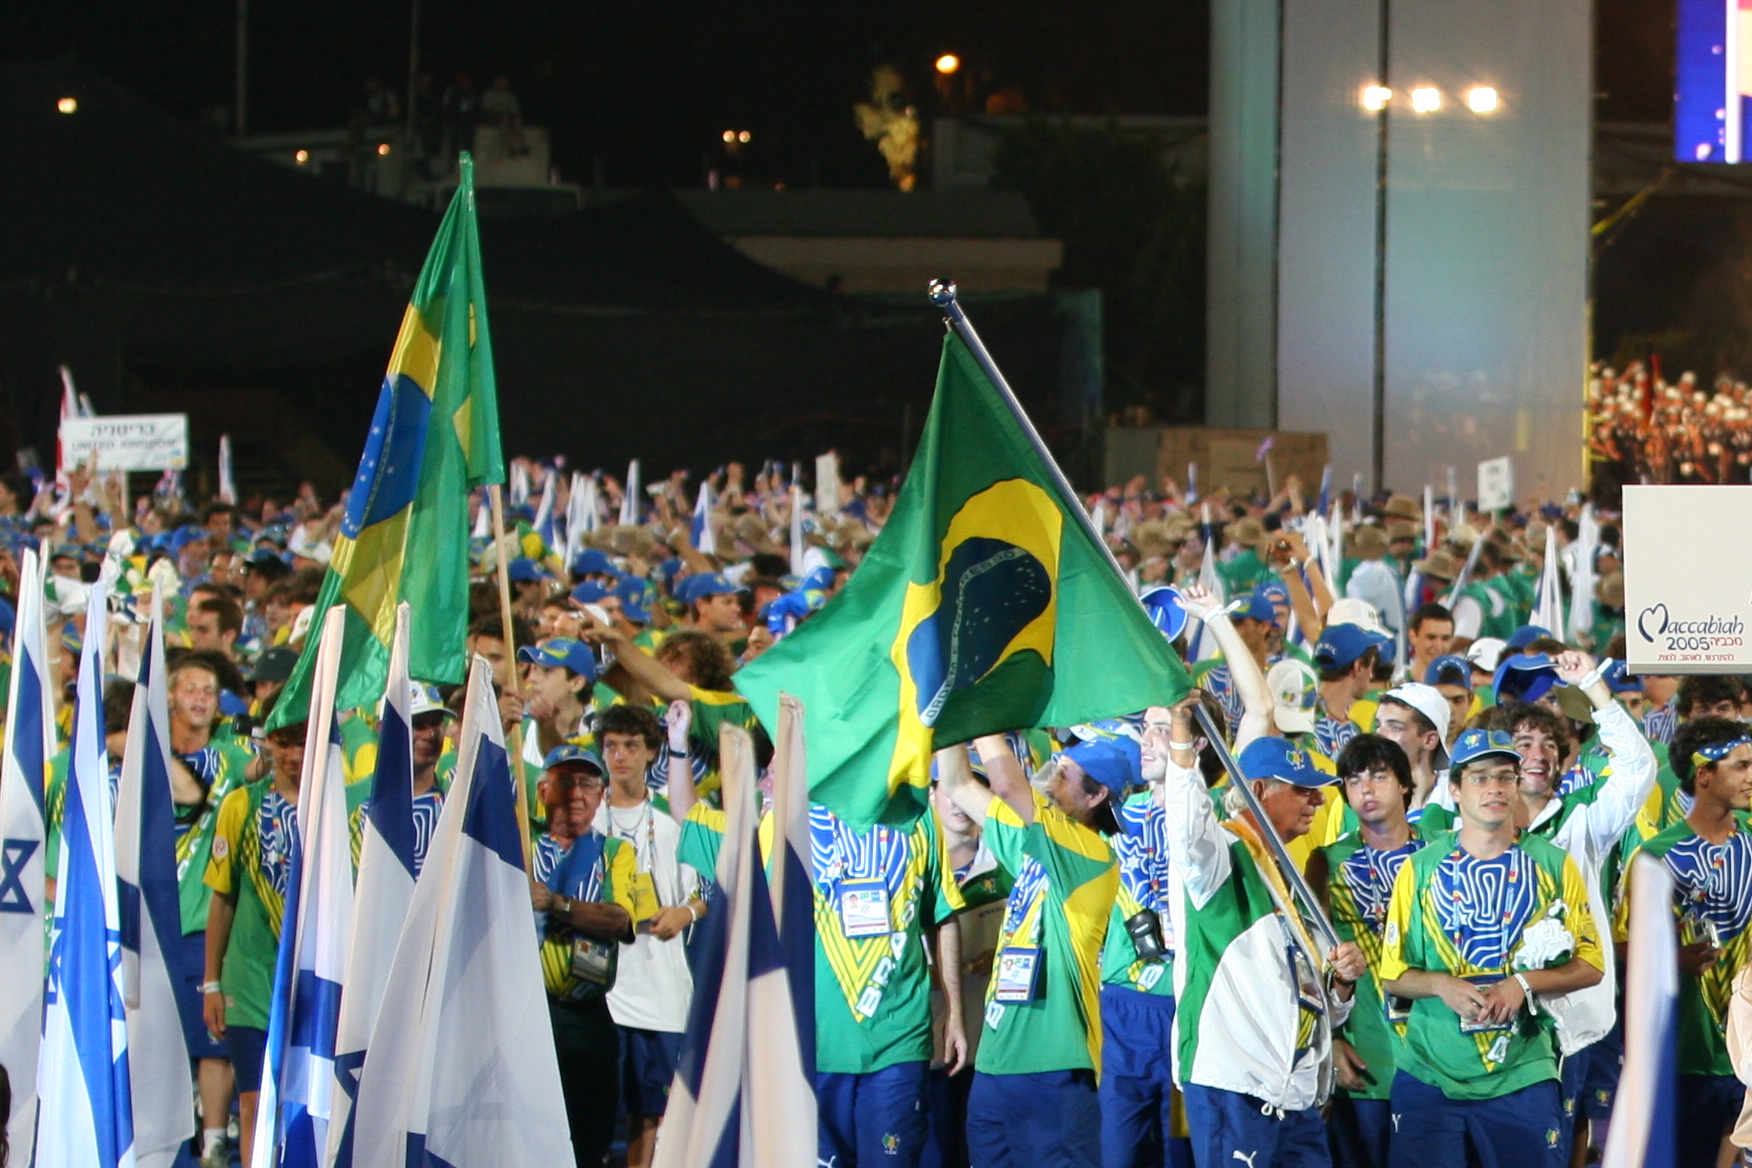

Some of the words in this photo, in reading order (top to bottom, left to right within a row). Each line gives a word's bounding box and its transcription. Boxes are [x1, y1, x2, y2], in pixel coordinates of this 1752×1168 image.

[1638, 603, 1744, 643] Maccabiah
[1666, 637, 1710, 650] 2005
[1710, 636, 1743, 647] מכביה
